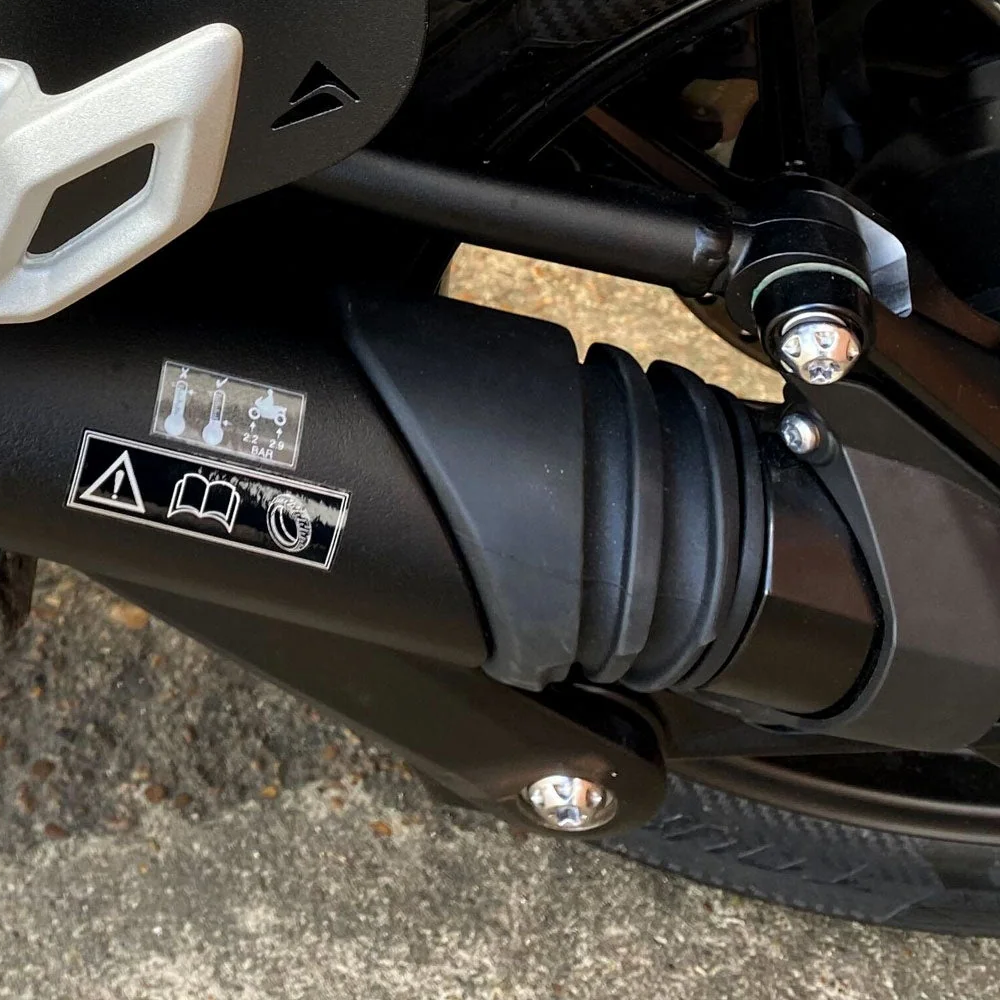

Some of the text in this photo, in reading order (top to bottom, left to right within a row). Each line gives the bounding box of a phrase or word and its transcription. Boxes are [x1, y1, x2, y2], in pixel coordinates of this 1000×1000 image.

[242, 432, 285, 451] 2.2 2.9
[251, 445, 274, 460] BAR
